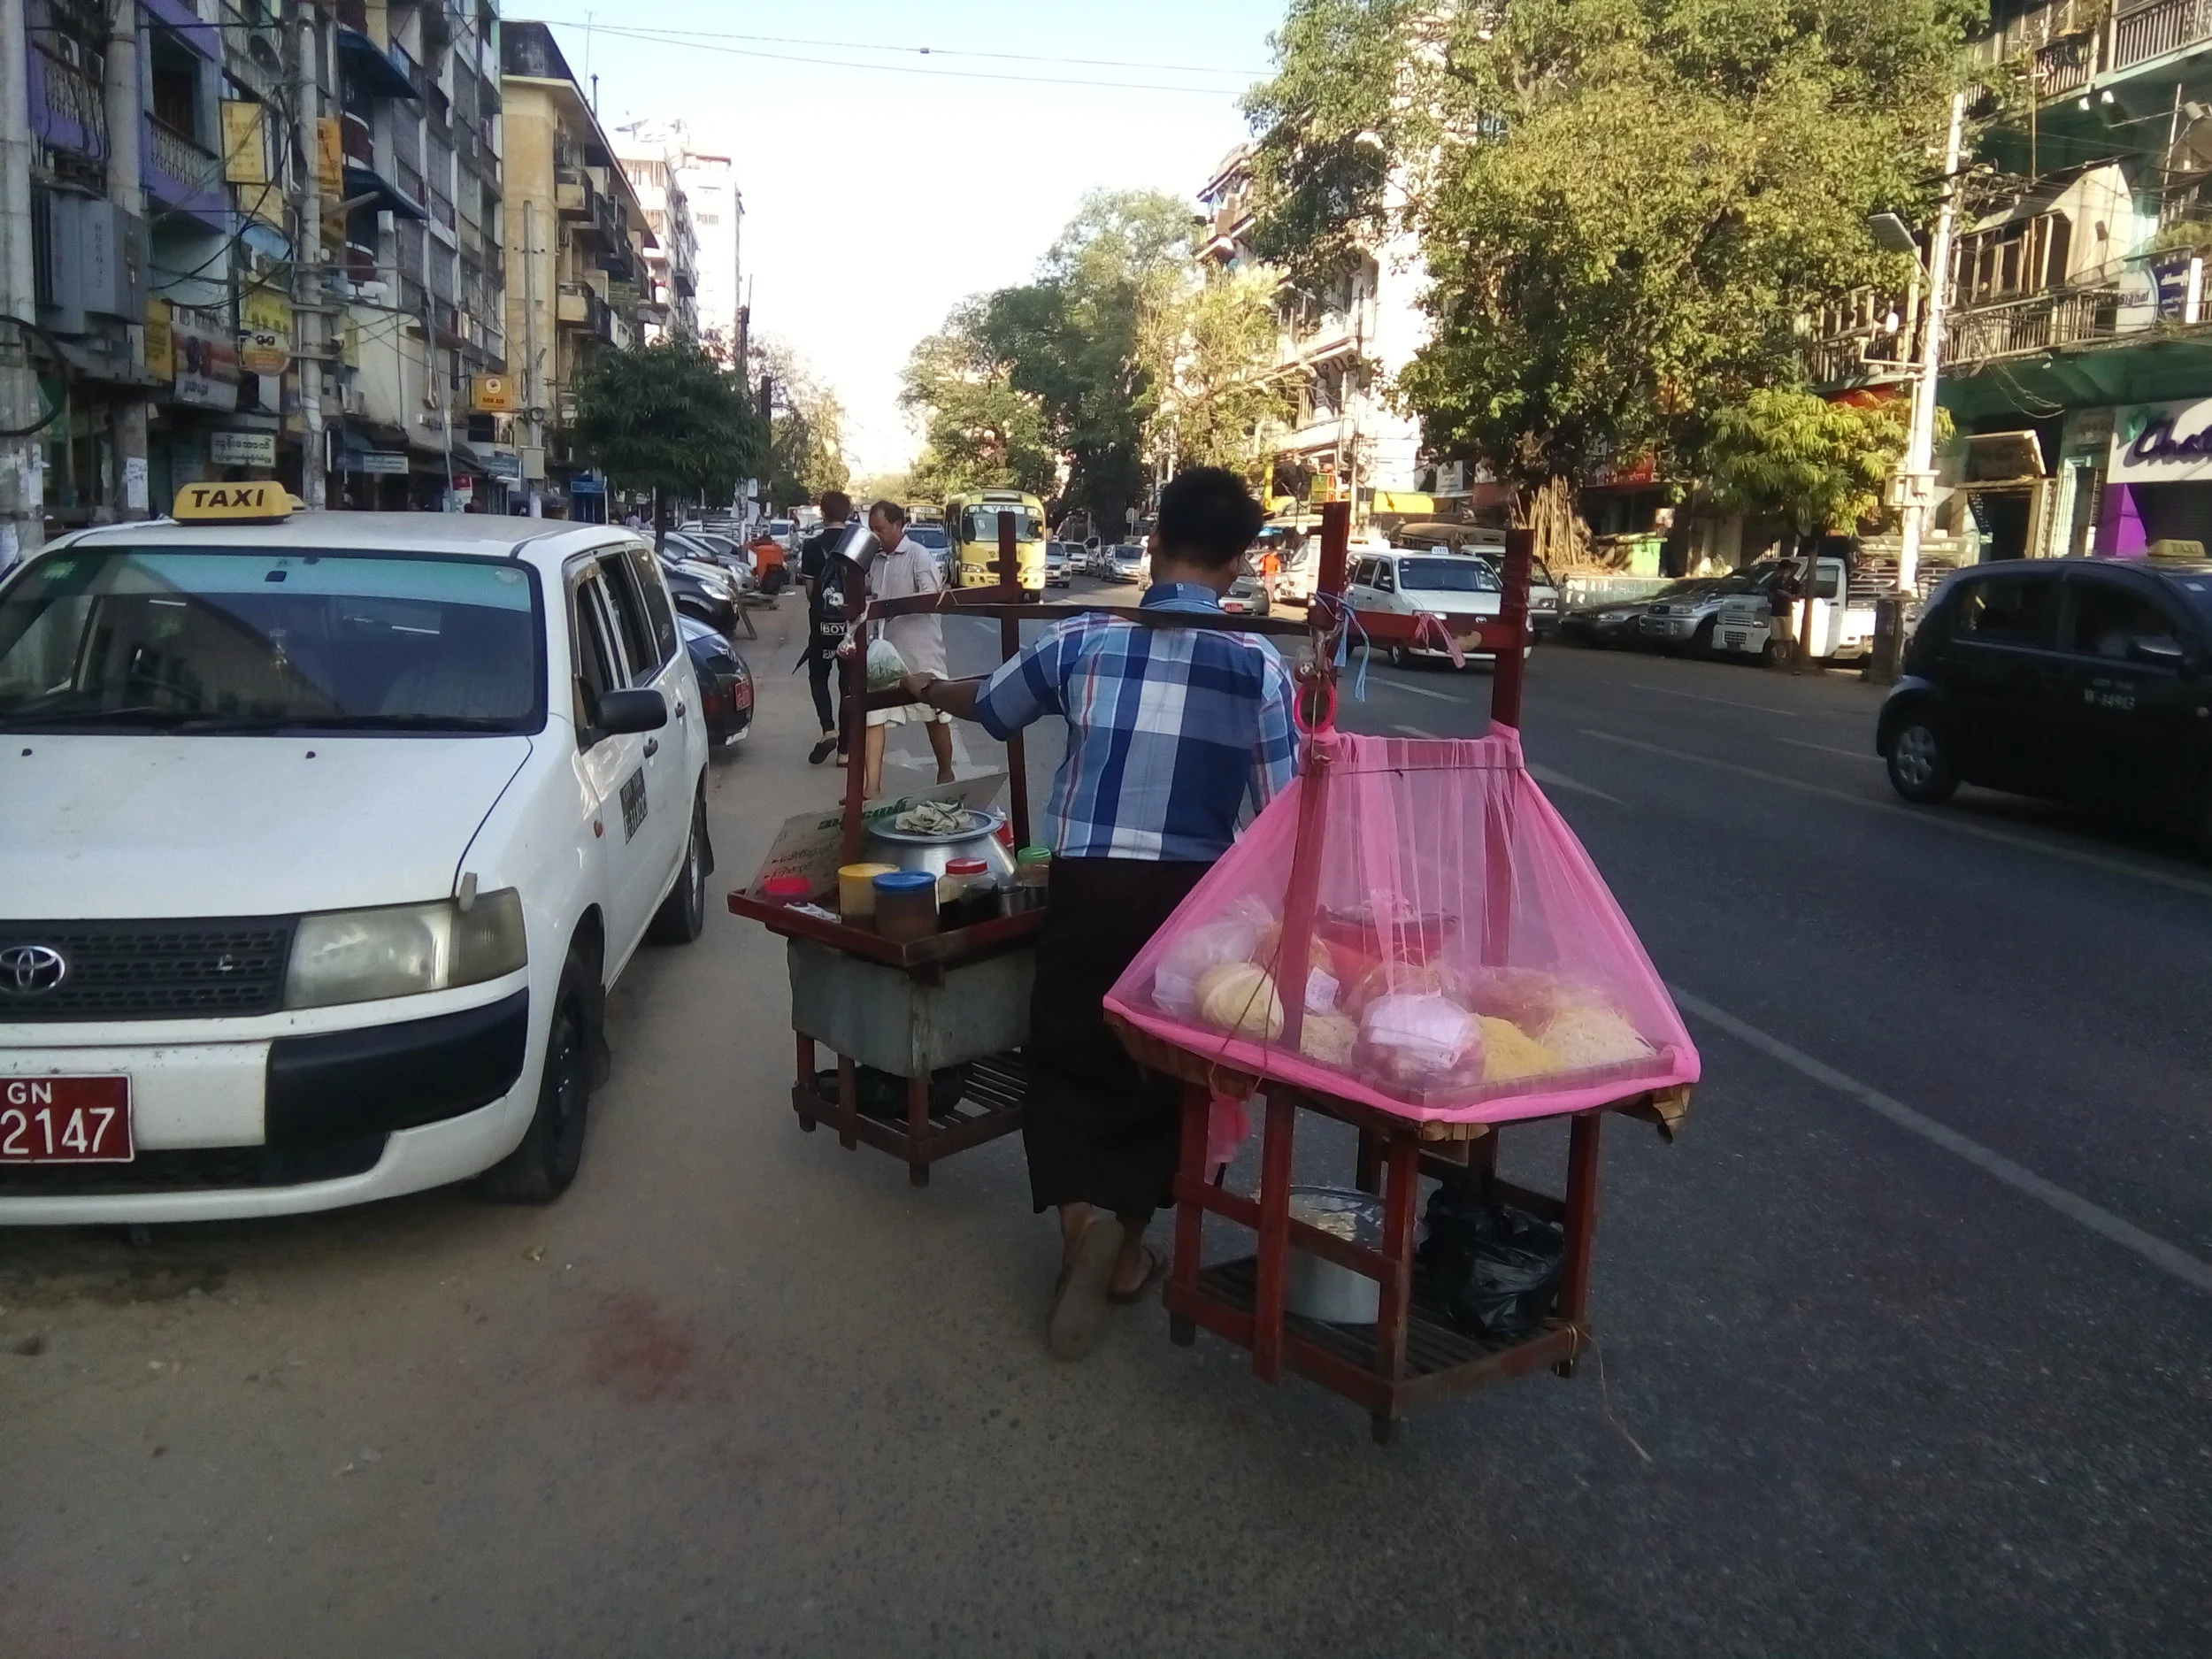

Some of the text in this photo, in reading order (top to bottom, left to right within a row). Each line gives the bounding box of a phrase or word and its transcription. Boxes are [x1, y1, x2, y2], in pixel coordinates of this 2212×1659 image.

[2119, 289, 2150, 306] Signal
[191, 488, 265, 508] TAXI
[2170, 542, 2200, 553] TAXI
[823, 623, 846, 634] BOY
[7, 1082, 52, 1104] GN
[0, 1108, 115, 1154] 2147
